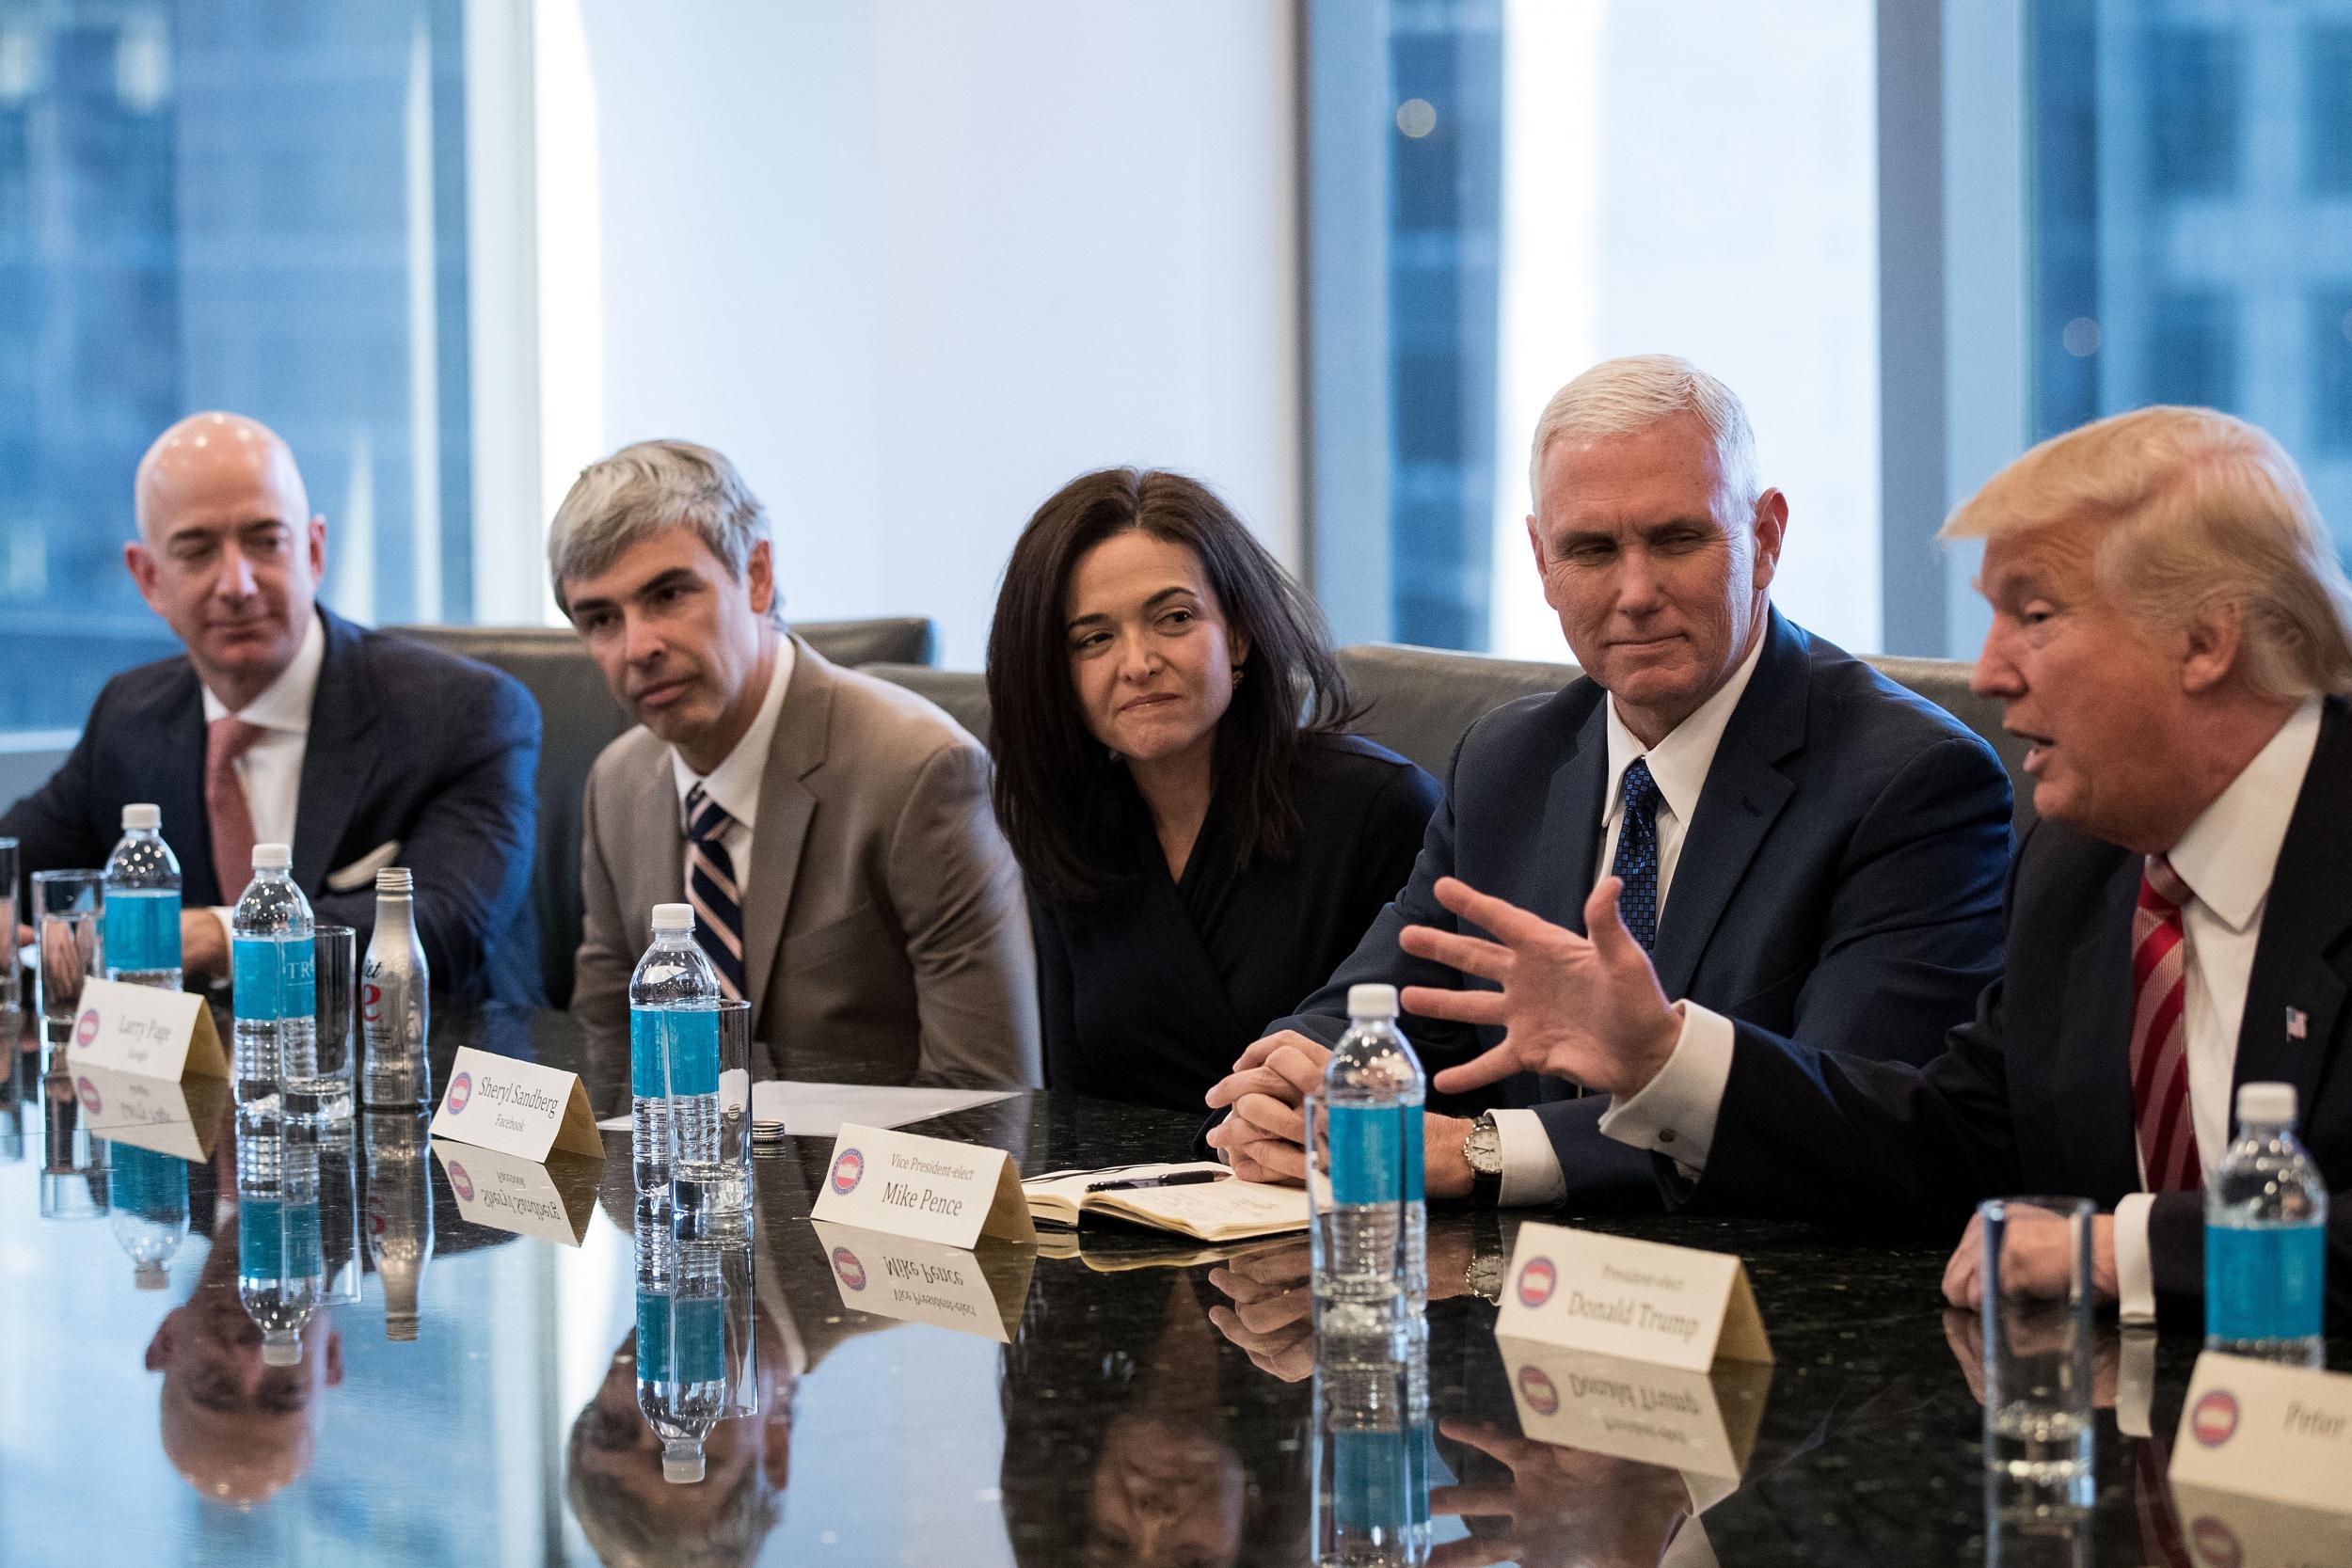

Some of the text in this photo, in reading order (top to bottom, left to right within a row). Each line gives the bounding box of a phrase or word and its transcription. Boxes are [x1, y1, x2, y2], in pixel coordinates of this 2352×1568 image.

[119, 1013, 172, 1046] Larry Page
[479, 1076, 513, 1106] Sheryl
[511, 1085, 558, 1118] Sandberg
[495, 1114, 525, 1132] Facebook
[891, 1153, 975, 1181] Vice President-elect
[882, 1181, 962, 1216] Mike Pence
[1566, 1290, 1700, 1343] Donald Trump
[2283, 1400, 2346, 1439] Peter
